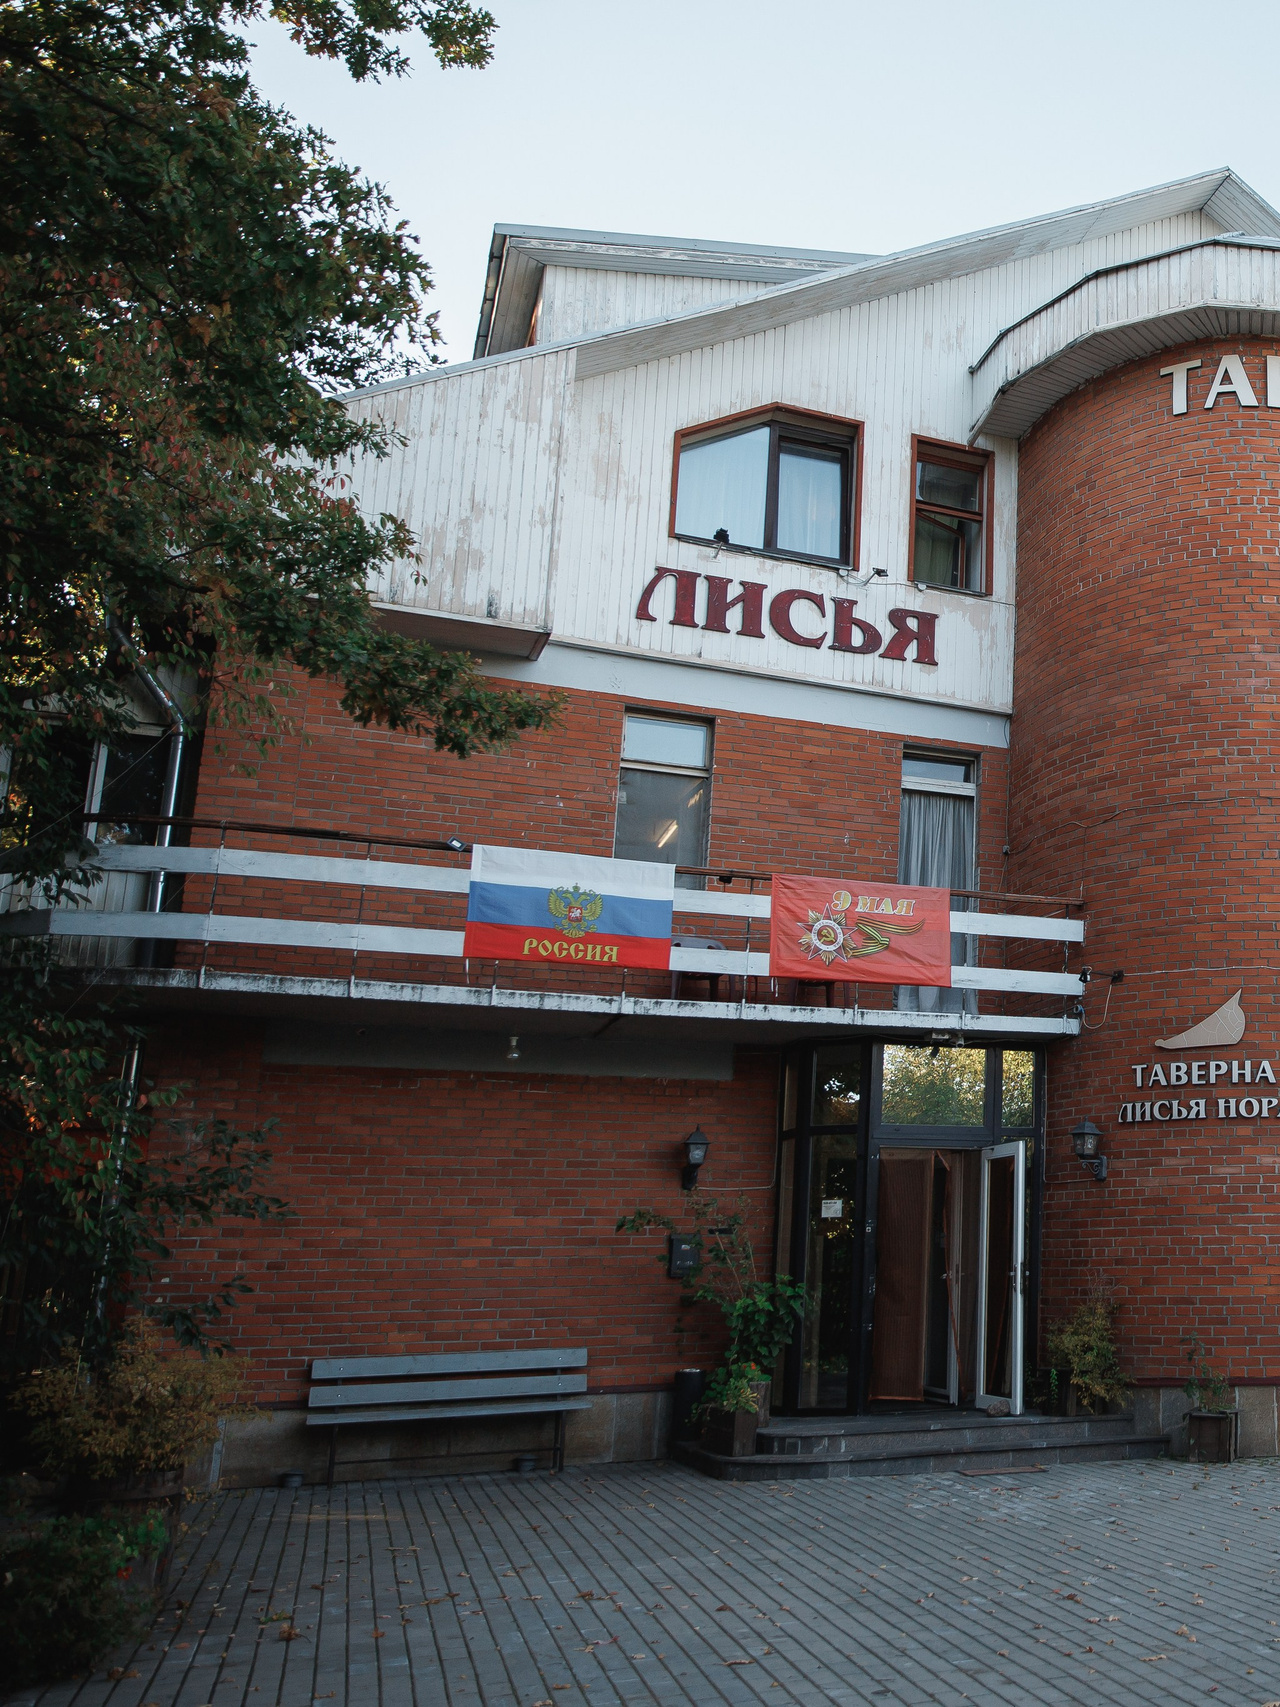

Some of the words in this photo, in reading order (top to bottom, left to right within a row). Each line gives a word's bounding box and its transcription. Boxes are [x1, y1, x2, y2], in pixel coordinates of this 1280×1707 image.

[635, 566, 940, 666] ЛИСЬЯ
[831, 890, 852, 911] 9
[855, 895, 916, 916] МАЯ
[522, 938, 619, 963] РОССИЯ
[1131, 1060, 1277, 1088] ТАВЕРНА
[1118, 1098, 1207, 1123] ЛИСЬЯ
